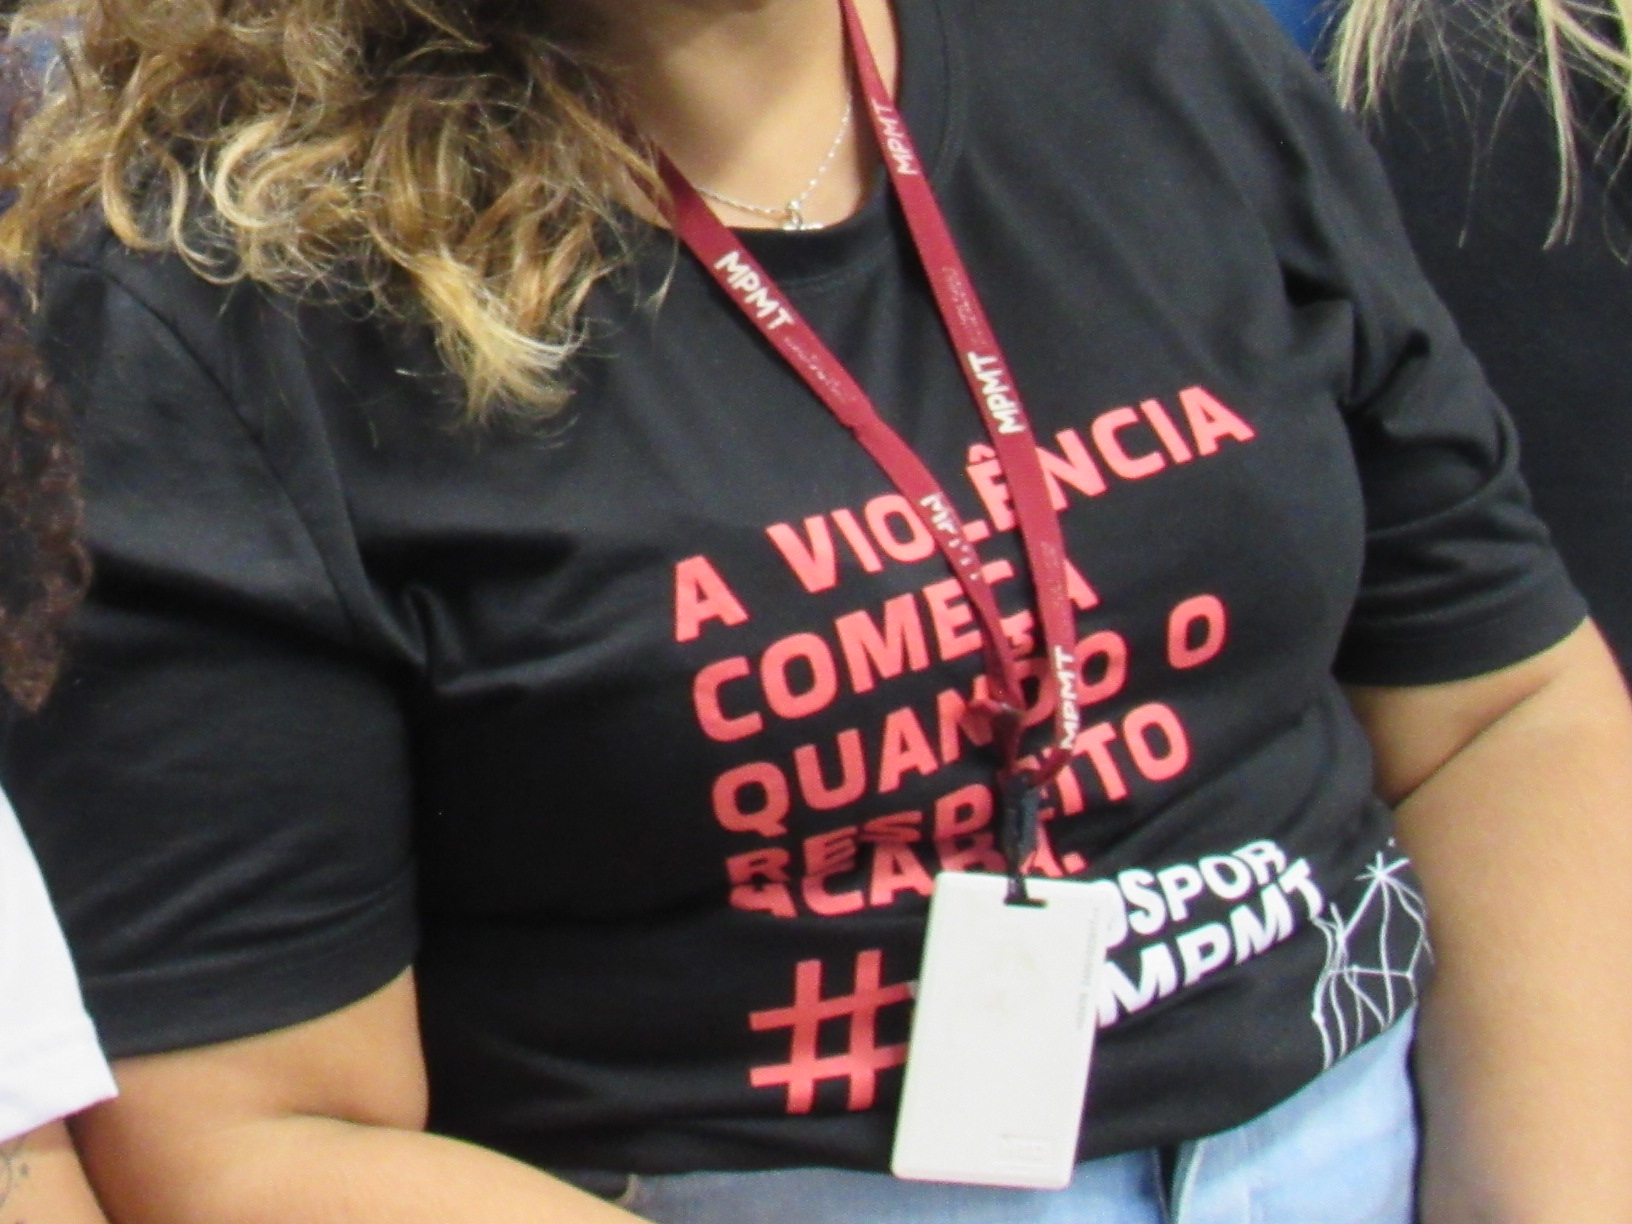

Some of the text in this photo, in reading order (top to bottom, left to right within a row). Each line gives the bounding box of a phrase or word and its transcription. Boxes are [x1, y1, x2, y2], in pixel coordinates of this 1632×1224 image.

[870, 98, 921, 176] MPMT
[714, 250, 795, 331] MPMT
[968, 351, 1025, 435] MPMT
[674, 555, 749, 643] A
[1167, 594, 1227, 670] O
[1052, 644, 1081, 750] MPMT
[726, 702, 1190, 883] RESPITO
